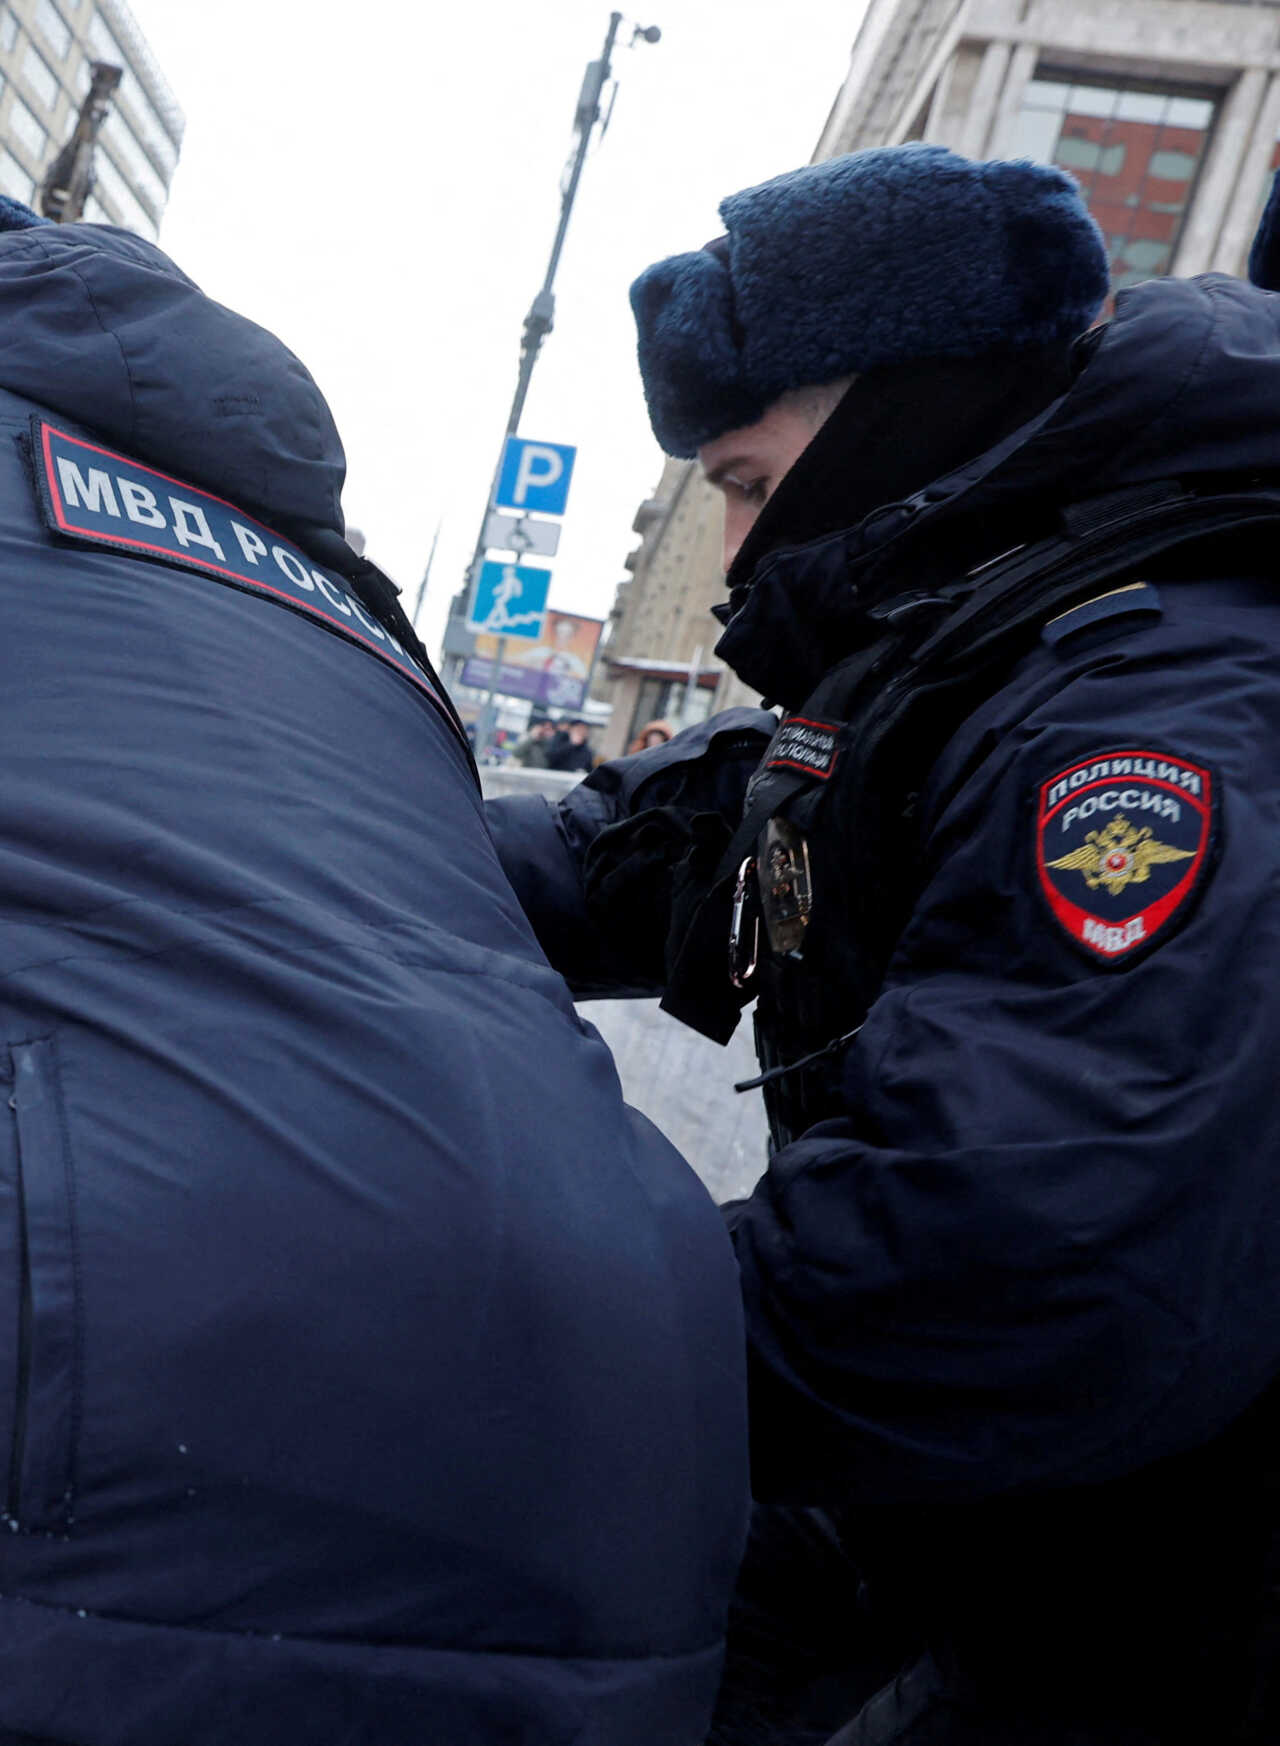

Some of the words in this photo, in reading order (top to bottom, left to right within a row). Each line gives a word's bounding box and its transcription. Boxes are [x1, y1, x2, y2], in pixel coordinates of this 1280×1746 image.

[513, 446, 563, 504] P
[56, 455, 226, 563] МВД
[230, 519, 419, 671] РОСС
[1048, 758, 1201, 807] ПОЛИЦИЯ
[1061, 789, 1180, 833] РОССИЯ
[1081, 916, 1146, 952] МВД
